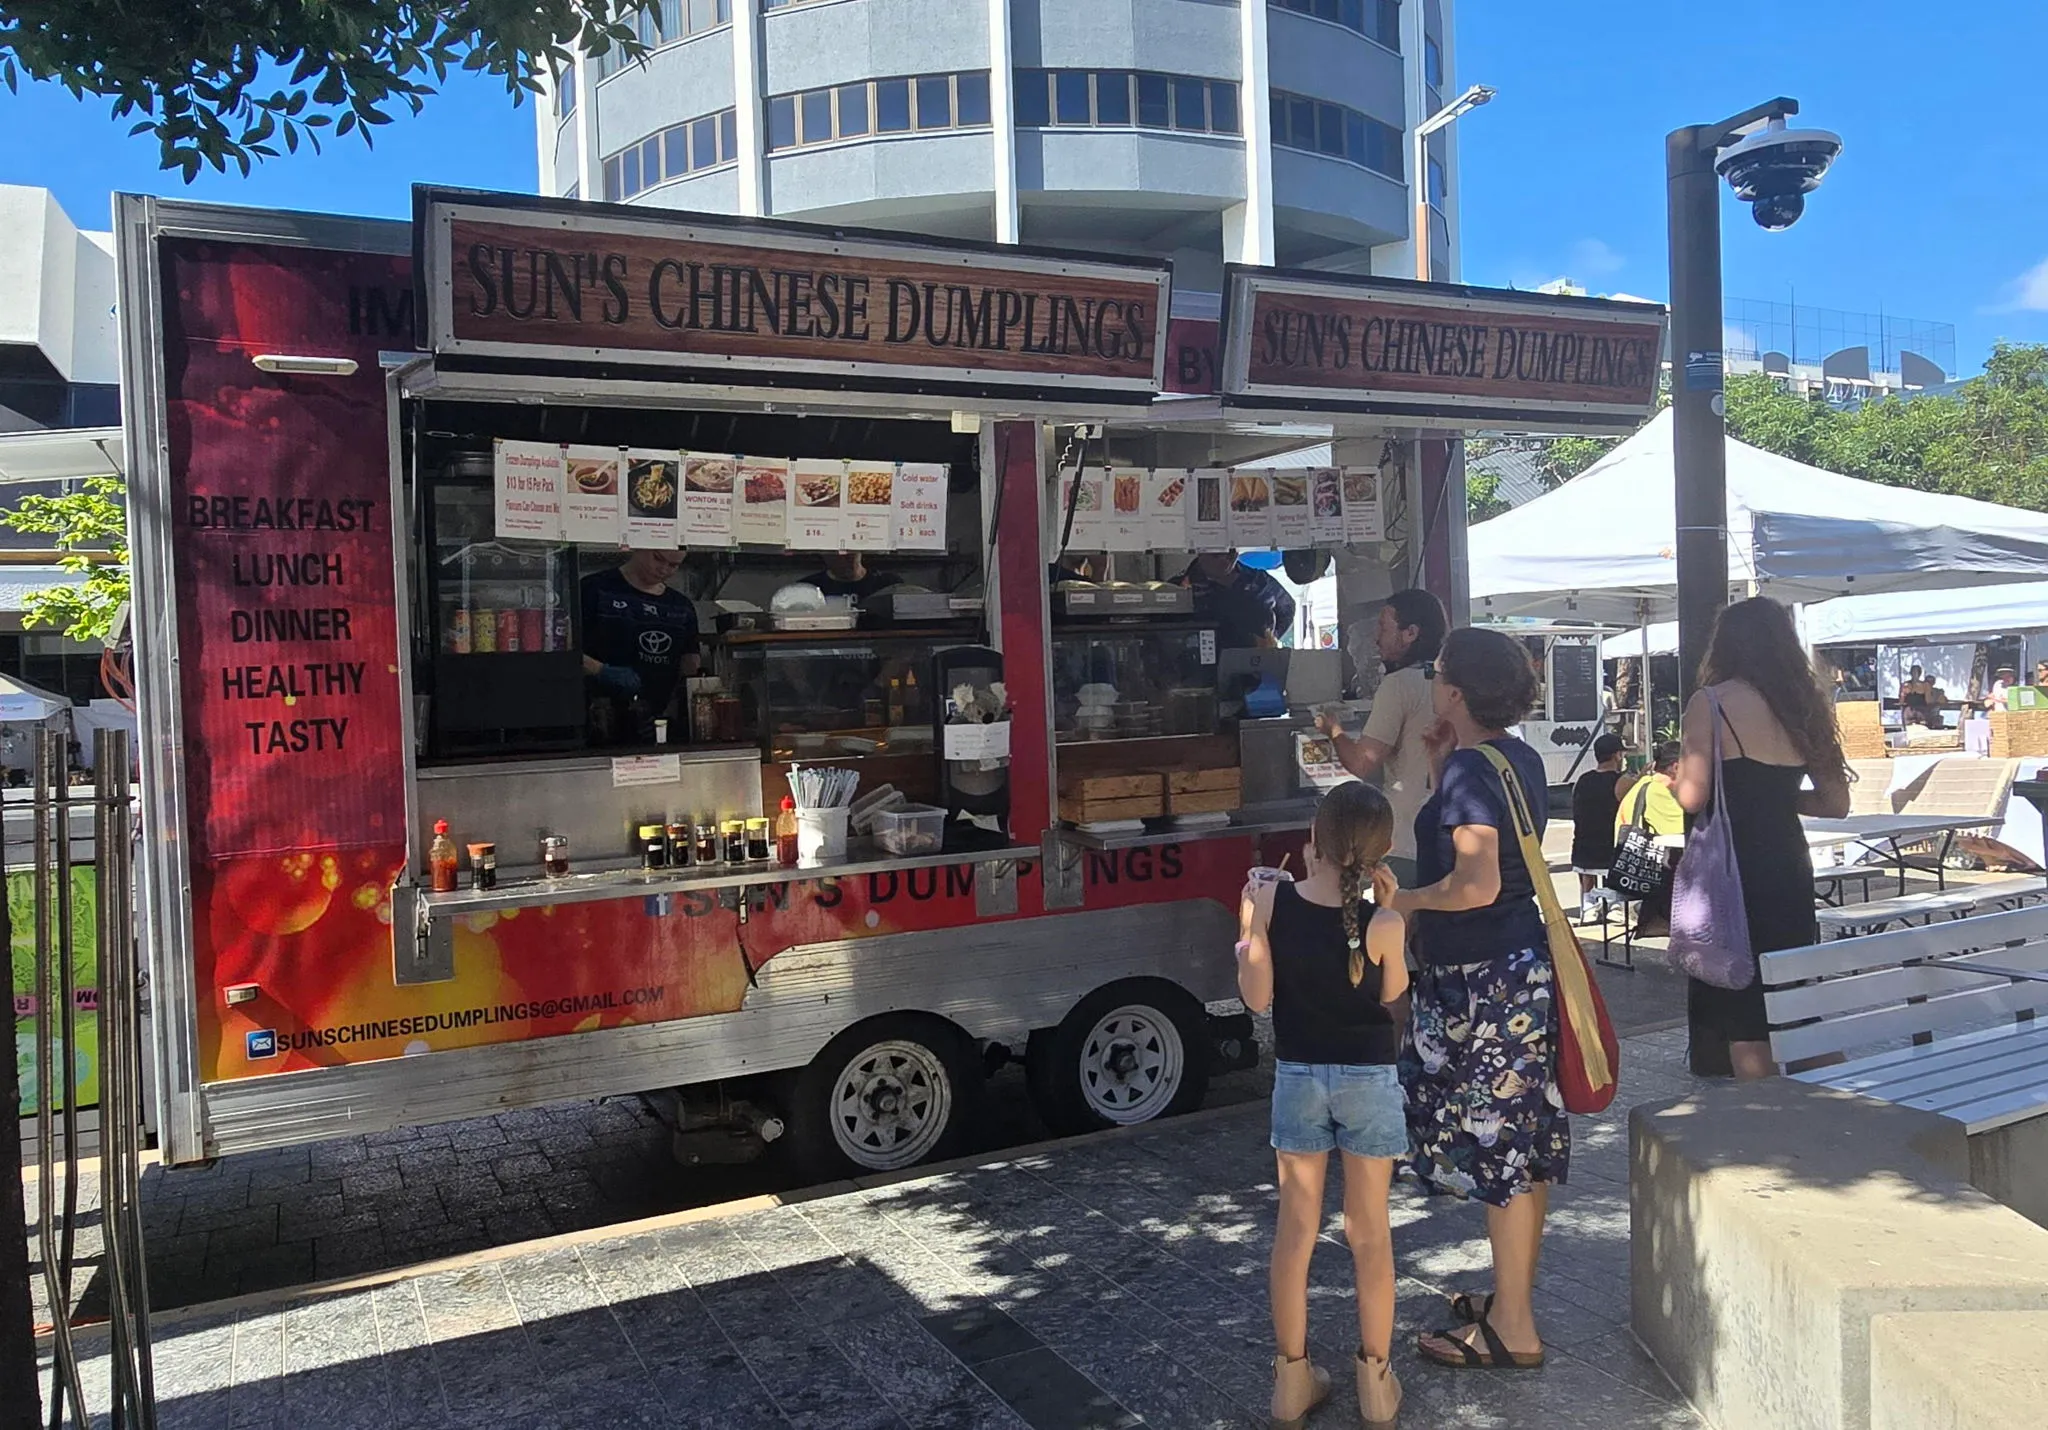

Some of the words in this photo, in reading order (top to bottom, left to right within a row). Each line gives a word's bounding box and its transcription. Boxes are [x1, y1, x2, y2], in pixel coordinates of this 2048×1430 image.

[467, 243, 628, 325] SUN'S
[650, 258, 870, 341] CHINESE
[885, 276, 1145, 362] DUMPLINGS
[1261, 309, 1352, 369] SUN'S
[1361, 317, 1488, 379] CHINESE
[1493, 326, 1651, 387] DUMPLINGS
[902, 474, 918, 483] Cold
[919, 475, 939, 483] water
[189, 495, 375, 532] BREAKFAST
[685, 495, 718, 505] WONTON
[901, 501, 915, 510] Soft
[916, 501, 938, 510] drinks
[919, 529, 937, 537] each
[233, 554, 343, 586] LUNCH
[231, 608, 352, 642] DINNER
[222, 662, 365, 700] HEALTHY
[245, 717, 348, 755] TASTY
[682, 876, 843, 917] SN'S
[870, 845, 1184, 903] DUMNGS
[1619, 876, 1650, 893] one
[276, 987, 664, 1052] SUNSCHINESEDUMPLINGS@GMAIL.COM
